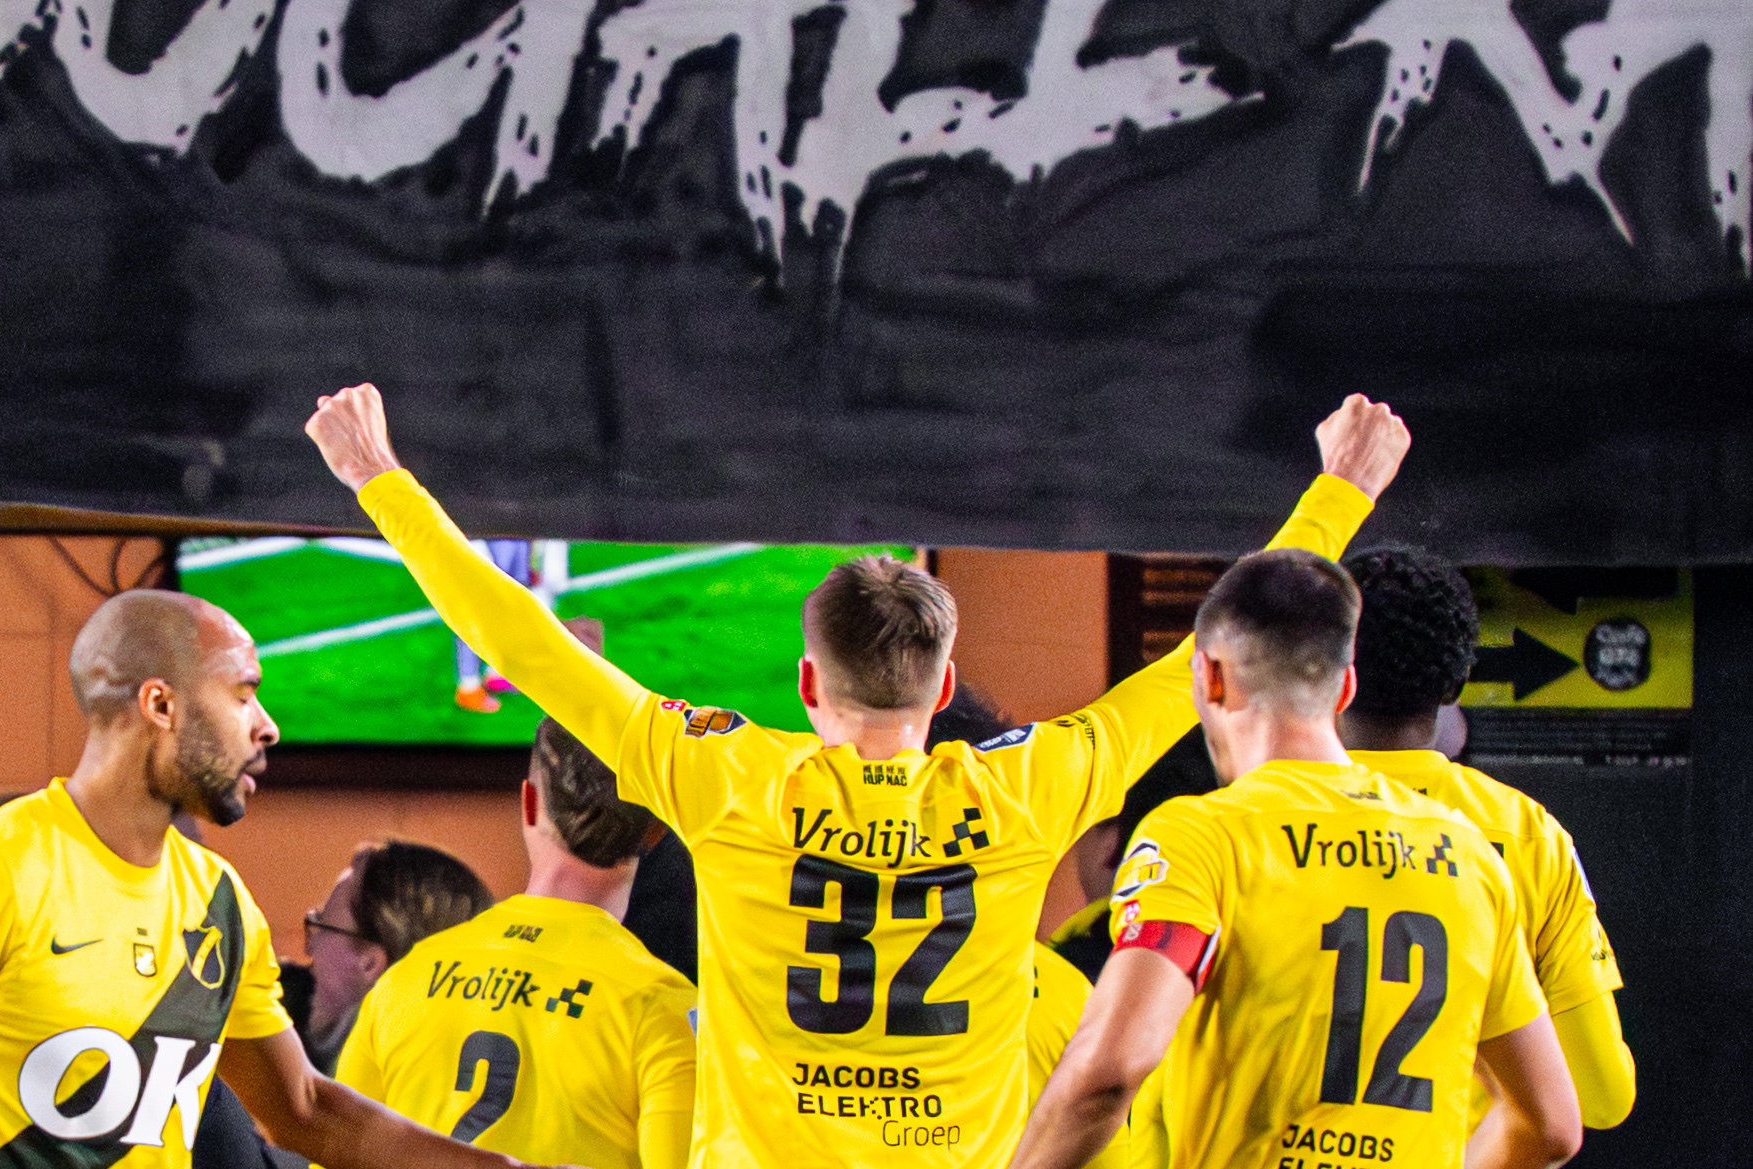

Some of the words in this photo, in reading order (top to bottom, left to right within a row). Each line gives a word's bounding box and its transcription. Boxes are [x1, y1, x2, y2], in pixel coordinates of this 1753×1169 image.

[886, 774, 907, 786] NAC
[792, 806, 932, 868] Vrolijk
[1281, 823, 1418, 880] Vrolijk
[786, 853, 978, 1037] 32
[427, 960, 541, 1012] Vrolijk
[1318, 905, 1449, 1113] 12
[451, 1029, 521, 1145] 2
[792, 1062, 921, 1090] JACOBS
[797, 1092, 943, 1120] ELEKTRO
[882, 1119, 962, 1152] Groep
[1282, 1123, 1395, 1163] JACOBS
